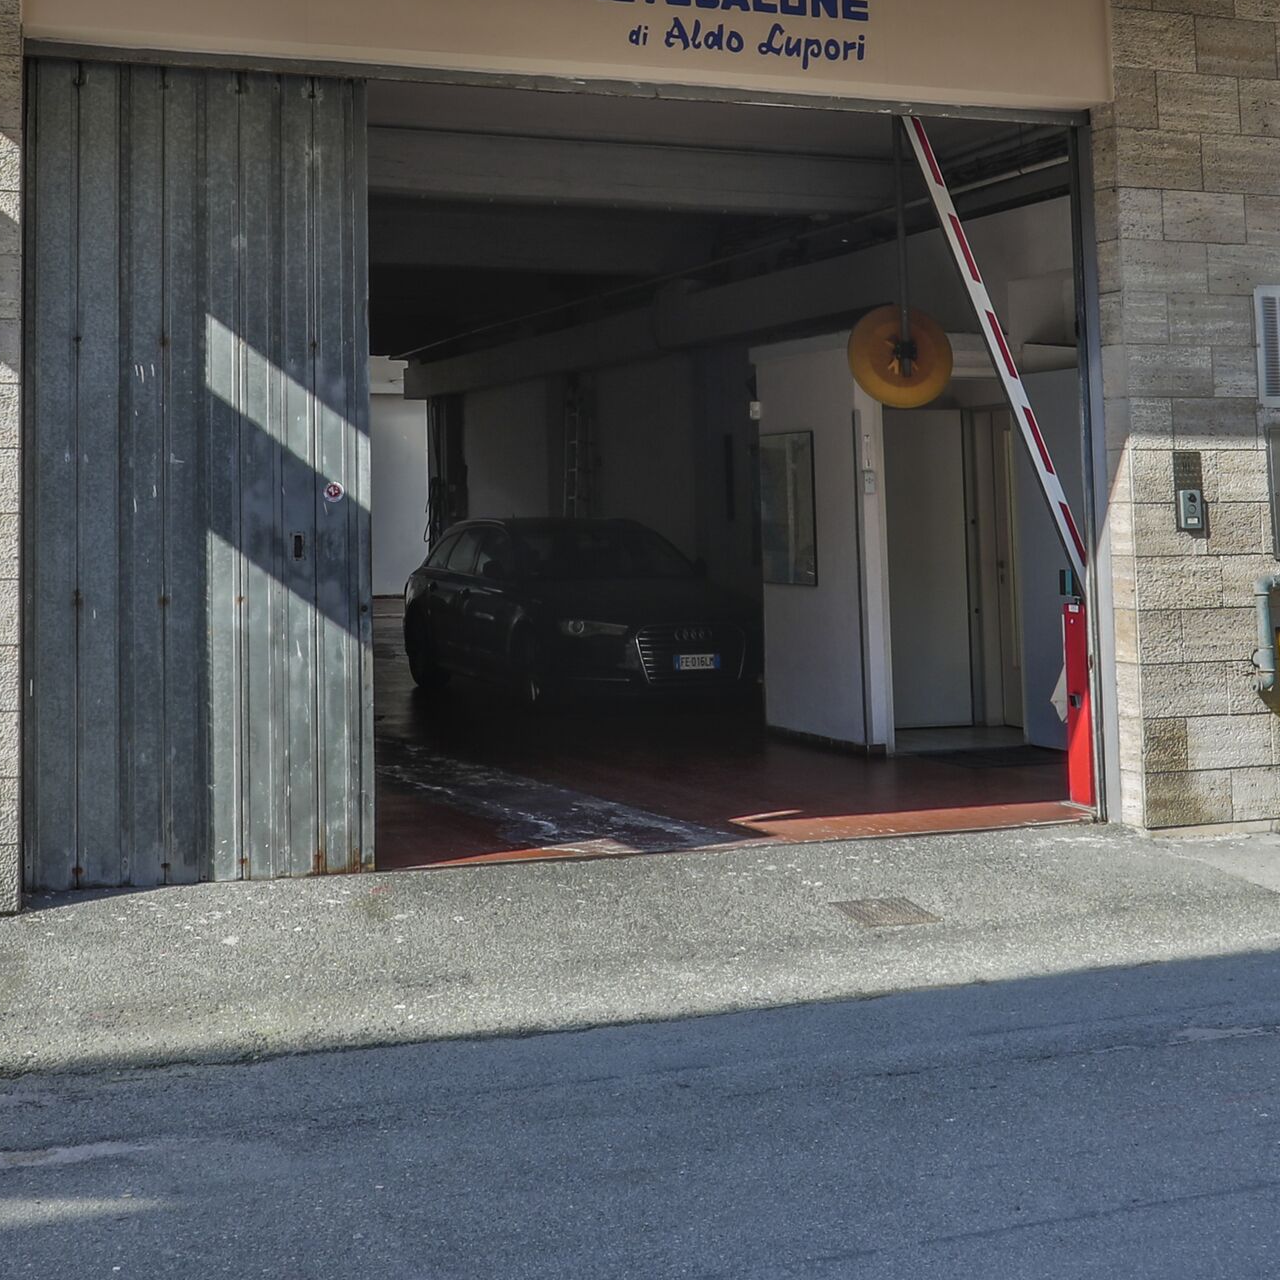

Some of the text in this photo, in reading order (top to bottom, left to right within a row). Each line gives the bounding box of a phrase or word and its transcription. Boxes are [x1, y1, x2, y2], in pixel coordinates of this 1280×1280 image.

[628, 17, 867, 70] di Aldo Lupori
